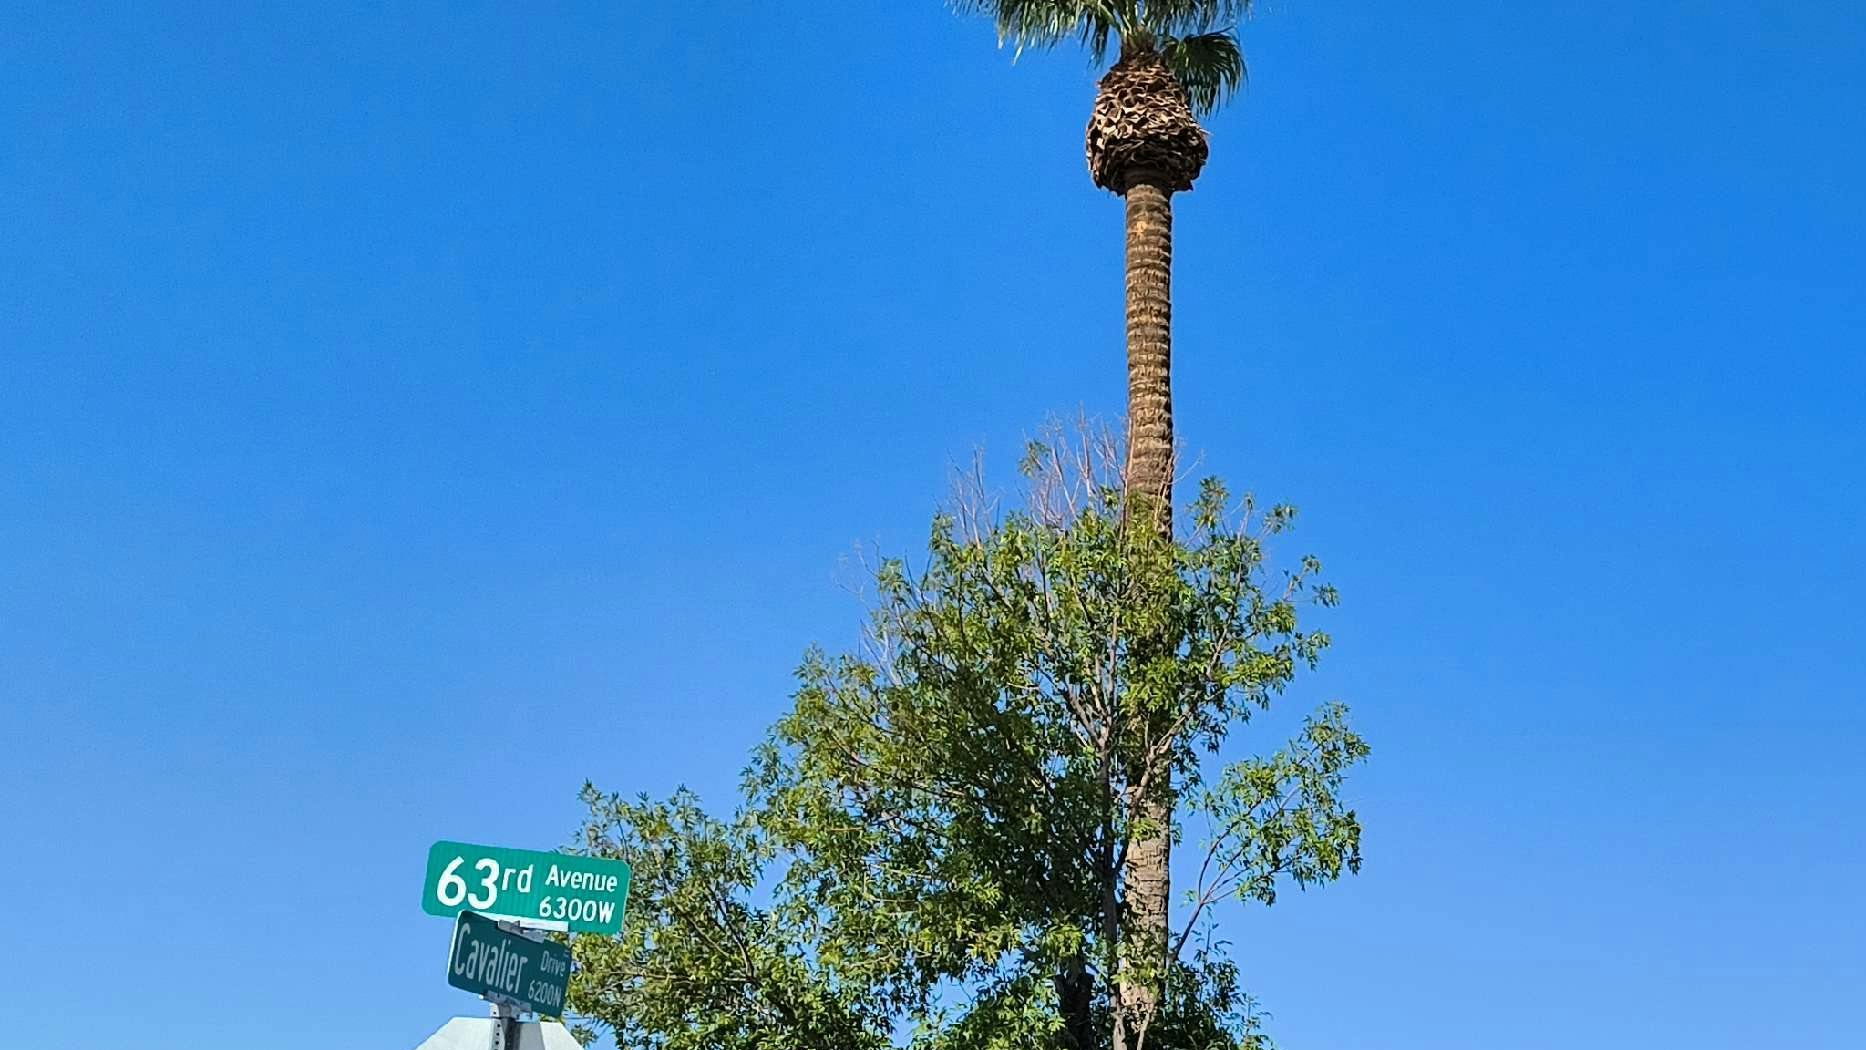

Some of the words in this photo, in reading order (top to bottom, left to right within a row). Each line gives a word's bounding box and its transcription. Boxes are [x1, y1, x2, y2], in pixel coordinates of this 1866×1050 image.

[436, 856, 534, 910] 63rd
[545, 864, 618, 893] Avenue
[539, 896, 615, 924] 6300W
[454, 922, 529, 994] Cavalier
[540, 950, 567, 977] Drive
[528, 979, 562, 1008] 6200N
